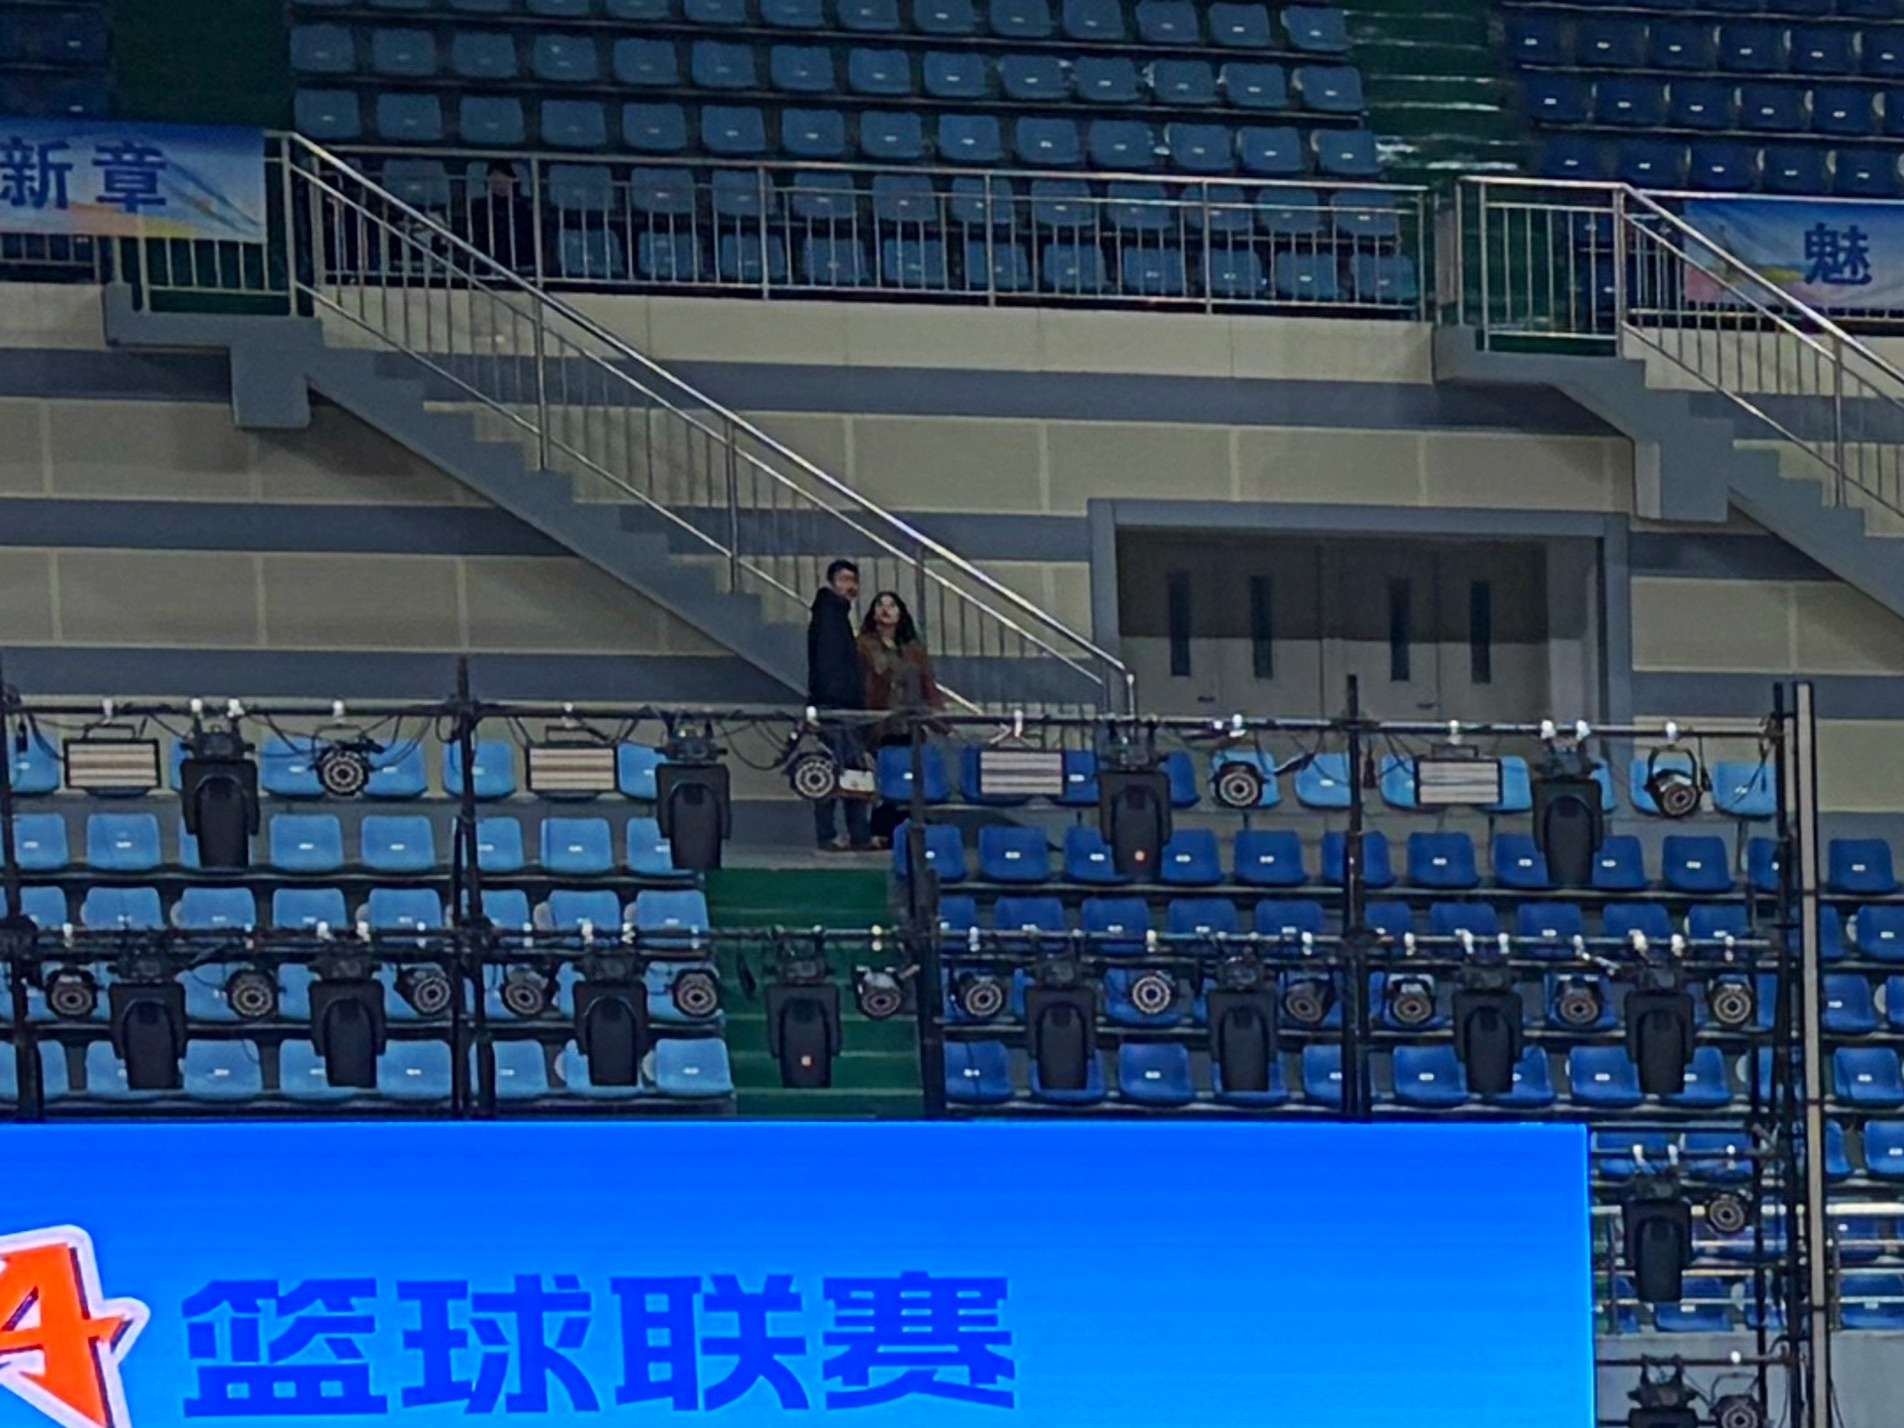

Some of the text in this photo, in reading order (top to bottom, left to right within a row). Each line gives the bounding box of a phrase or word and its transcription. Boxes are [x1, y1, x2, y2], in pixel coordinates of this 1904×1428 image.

[0, 135, 170, 215] 新章
[181, 1270, 1016, 1419] 篮球联赛
